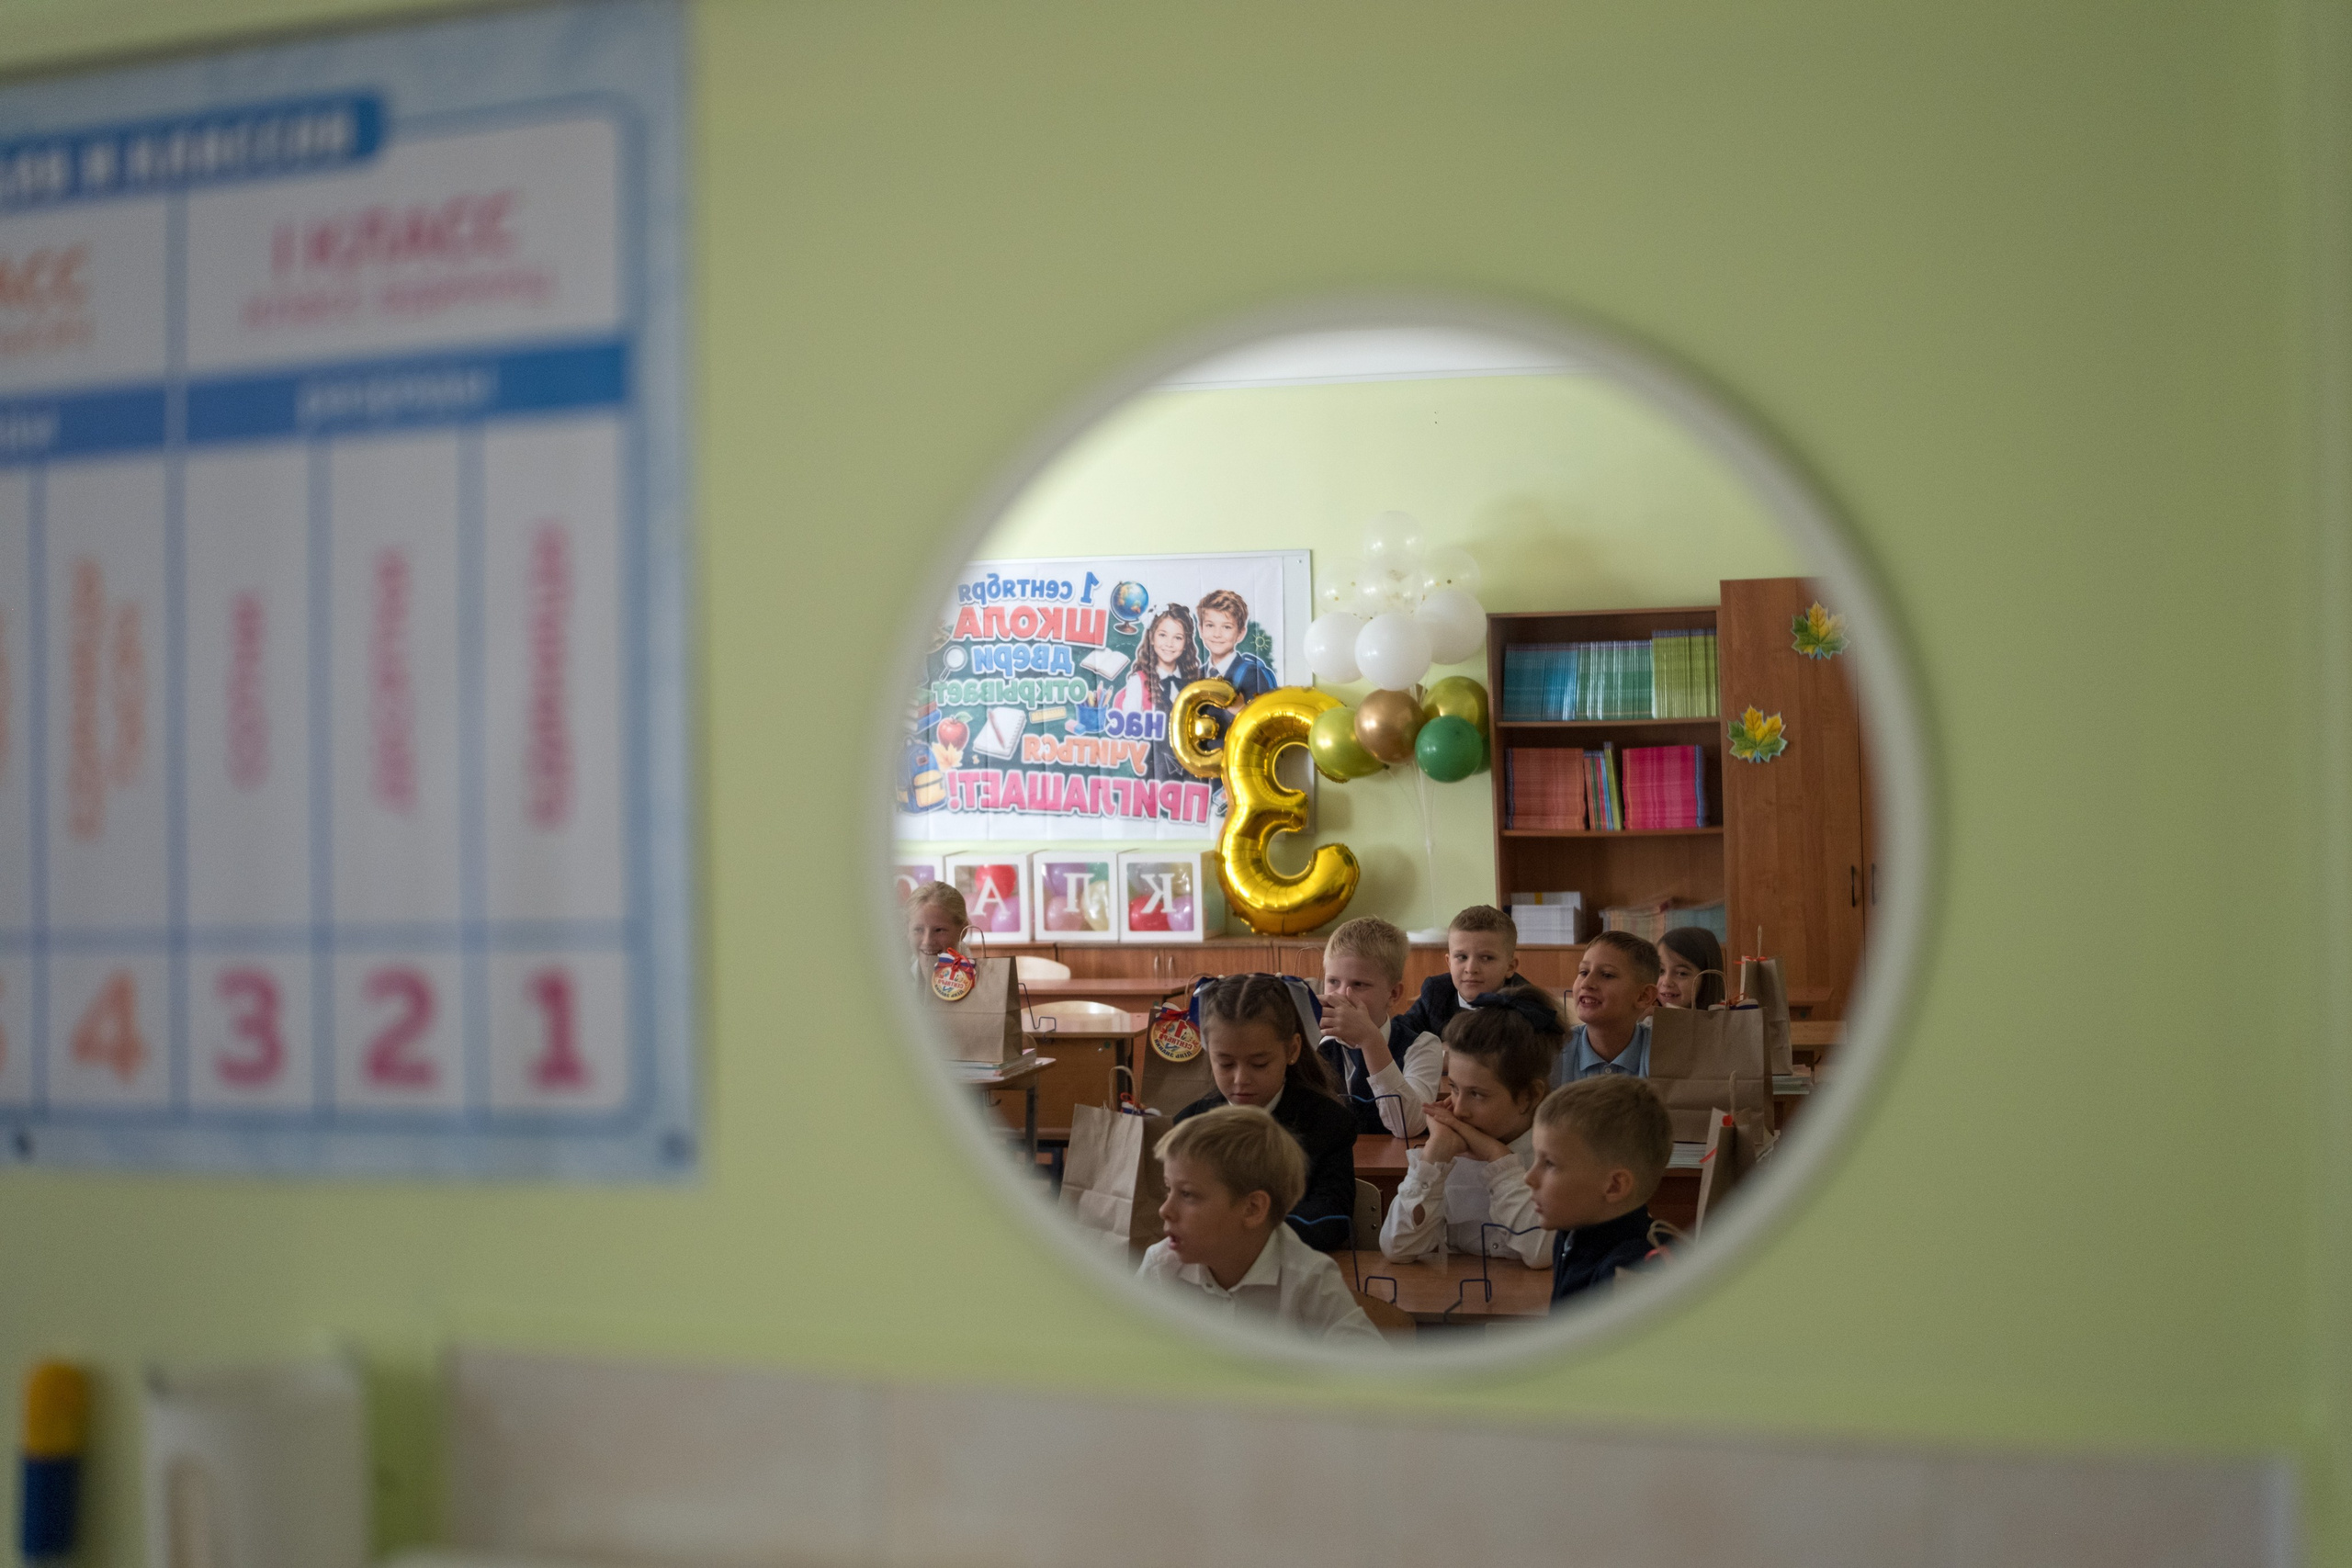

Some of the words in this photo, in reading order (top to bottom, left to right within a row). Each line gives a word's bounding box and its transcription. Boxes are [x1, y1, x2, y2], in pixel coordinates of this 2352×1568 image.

[73, 969, 149, 1087] 4
[213, 968, 287, 1089] 3
[361, 968, 441, 1089] 2
[527, 967, 595, 1090] 1
